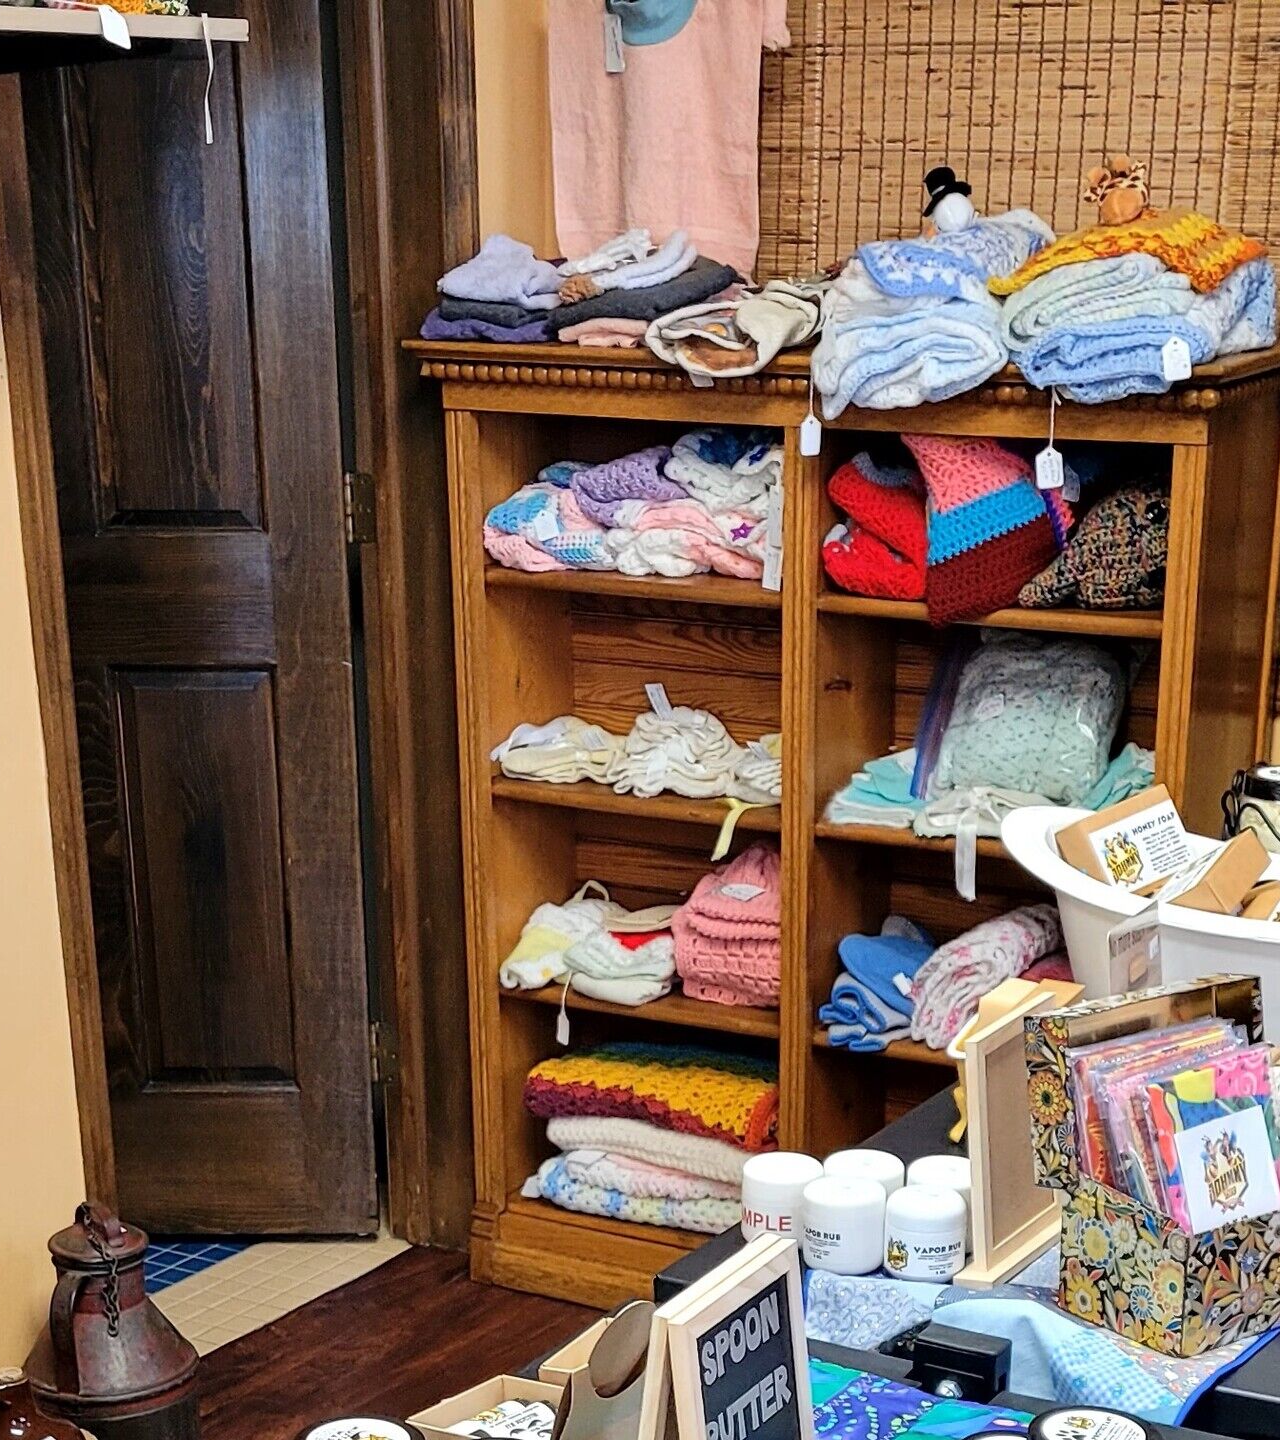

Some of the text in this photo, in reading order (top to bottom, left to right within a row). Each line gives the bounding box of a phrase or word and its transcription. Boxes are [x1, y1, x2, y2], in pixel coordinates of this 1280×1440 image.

[1132, 812, 1175, 836] HONEY SOAP
[914, 1244, 947, 1254] VAPOR
[701, 1291, 780, 1386] SPOON
